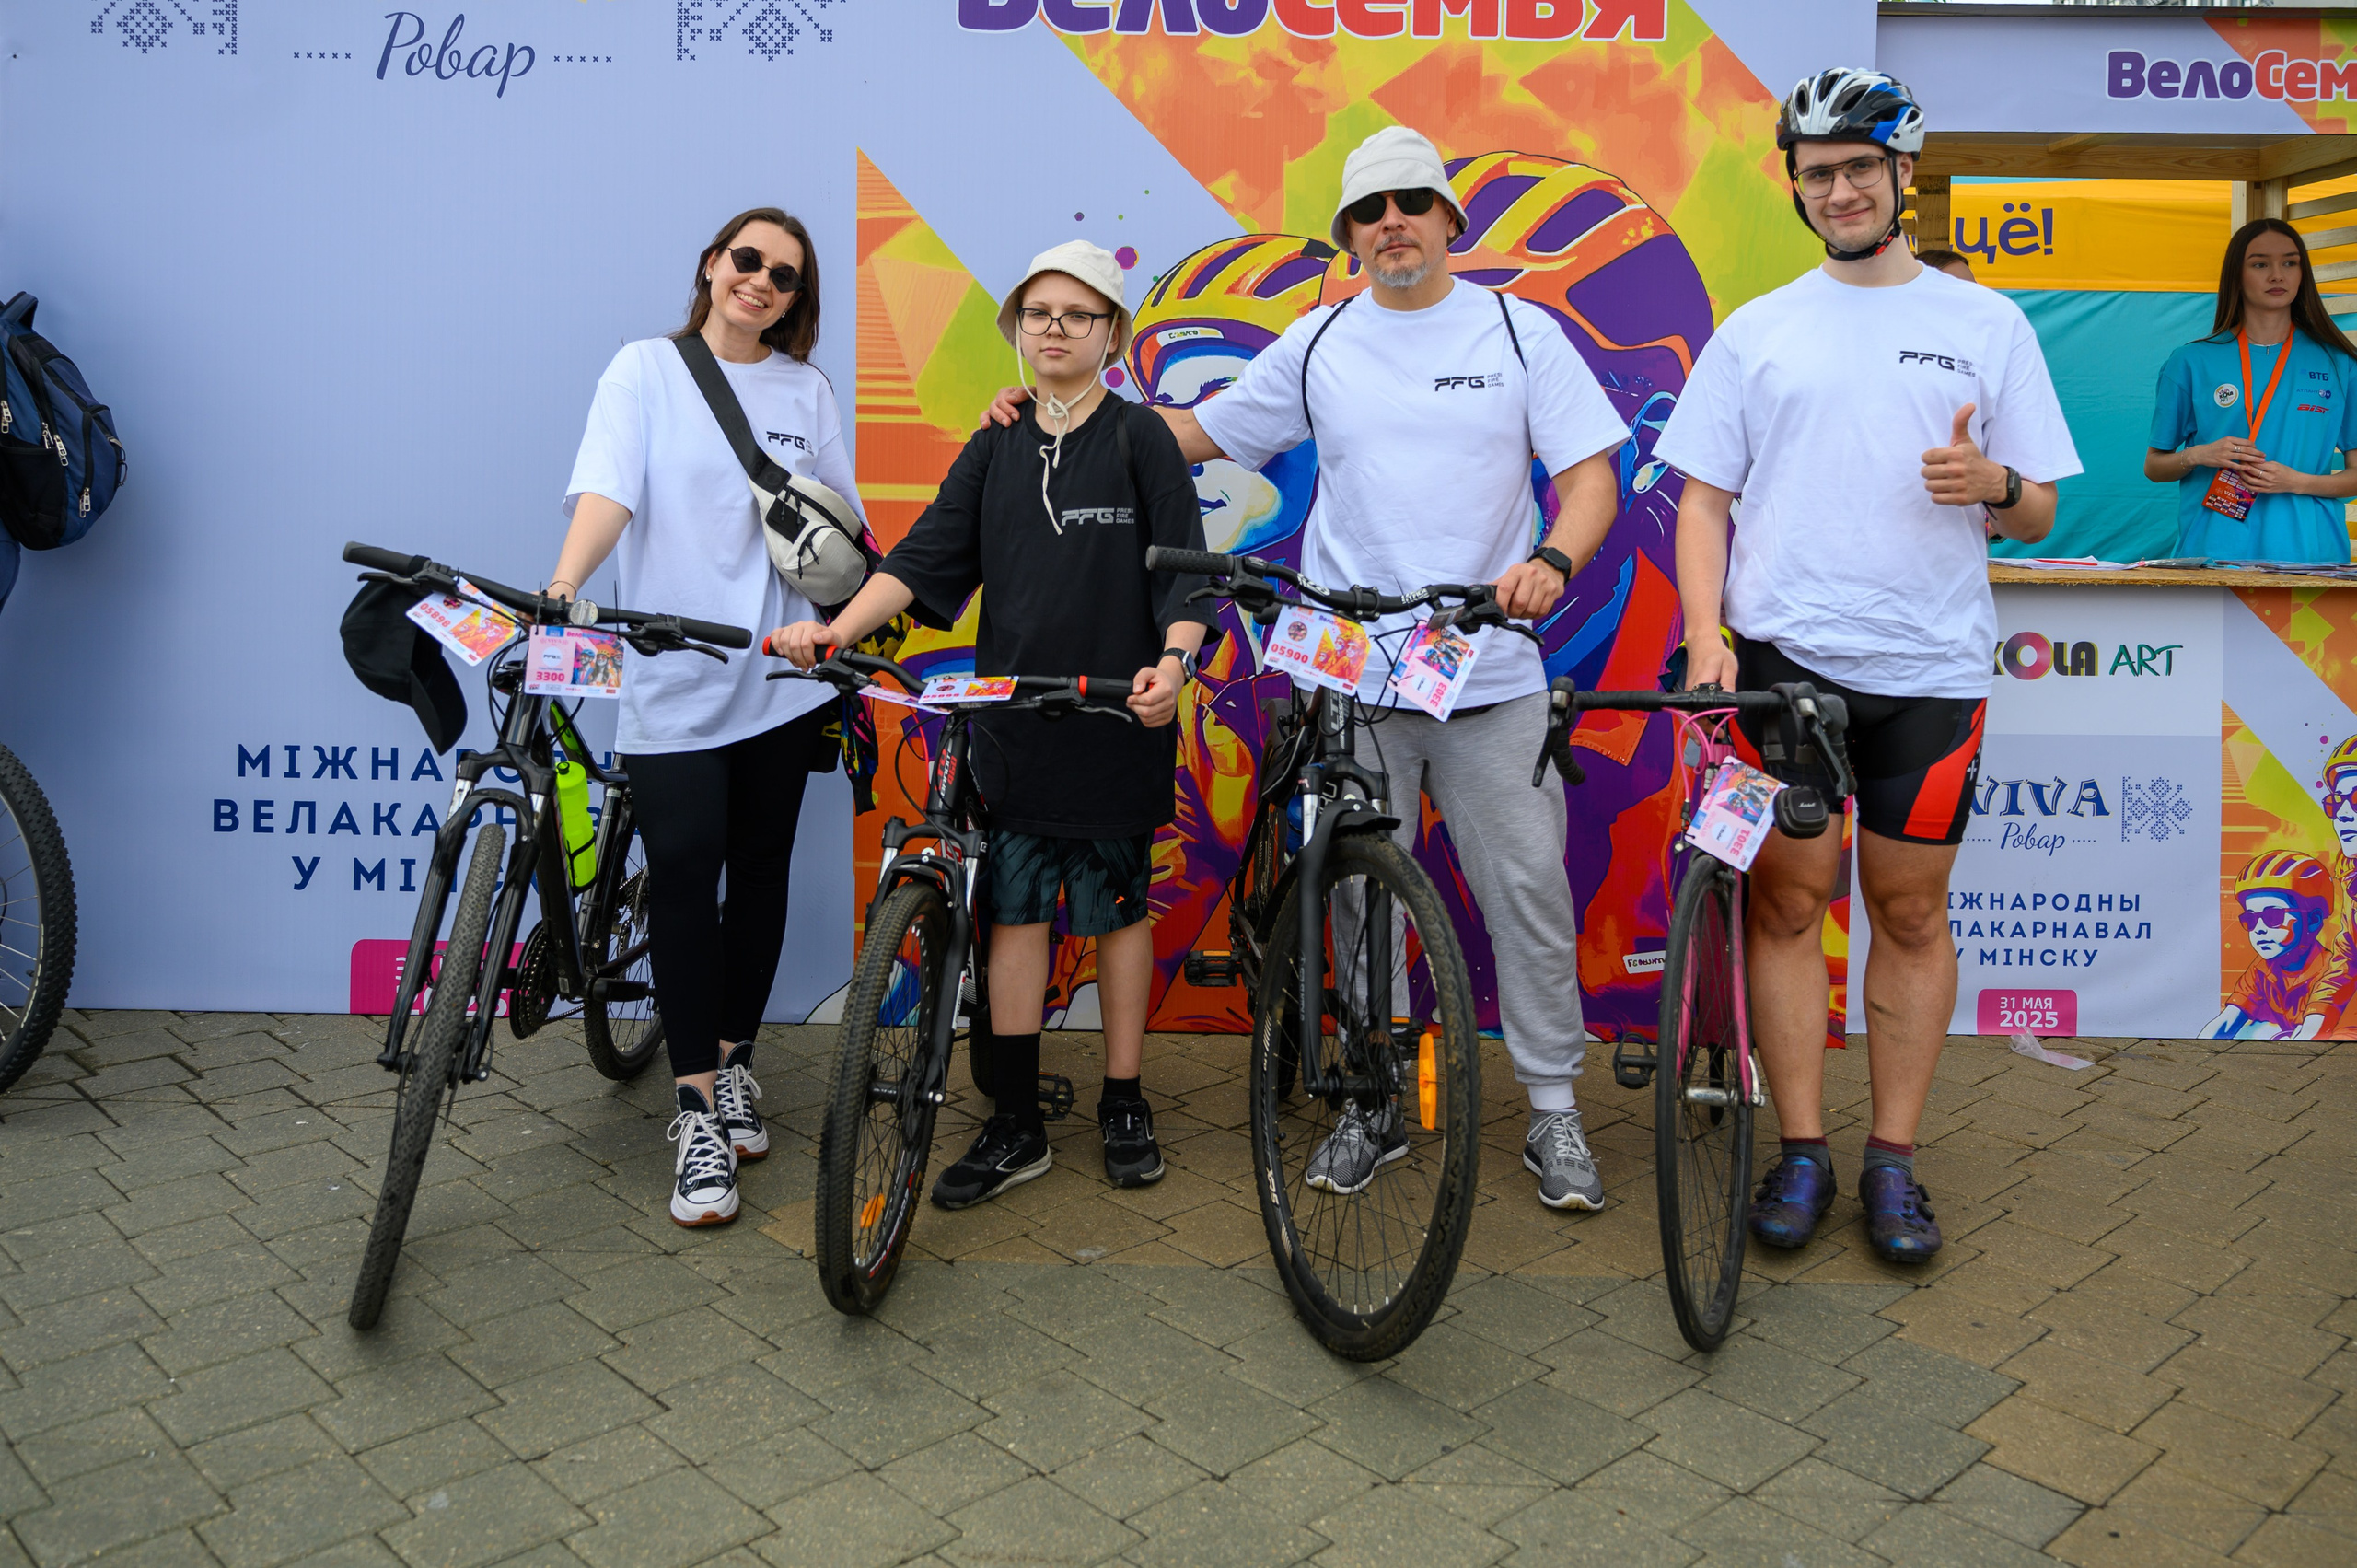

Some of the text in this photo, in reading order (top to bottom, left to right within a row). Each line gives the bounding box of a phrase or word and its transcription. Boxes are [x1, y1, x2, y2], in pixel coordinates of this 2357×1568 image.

[376, 11, 536, 99] Ровар
[1949, 203, 2054, 265] цё!
[1899, 350, 1956, 371] PFG
[1434, 375, 1485, 392] PFG
[2308, 371, 2329, 382] ВТБ
[766, 430, 806, 451] PFG
[1062, 507, 1115, 527] PFG
[420, 602, 452, 628] 05898
[1271, 643, 1309, 664] 05900
[2109, 644, 2184, 677] ART
[536, 671, 565, 682] 3300
[1429, 681, 1447, 708] 3303
[1970, 775, 2112, 818] VIVA
[1729, 829, 1751, 857] 3301
[2000, 822, 2065, 856] Ровар
[291, 856, 321, 890] У
[1980, 948, 2098, 967] МІНСКУ
[2000, 997, 2053, 1009] 31 МАЯ
[1999, 1011, 2059, 1028] 2025
